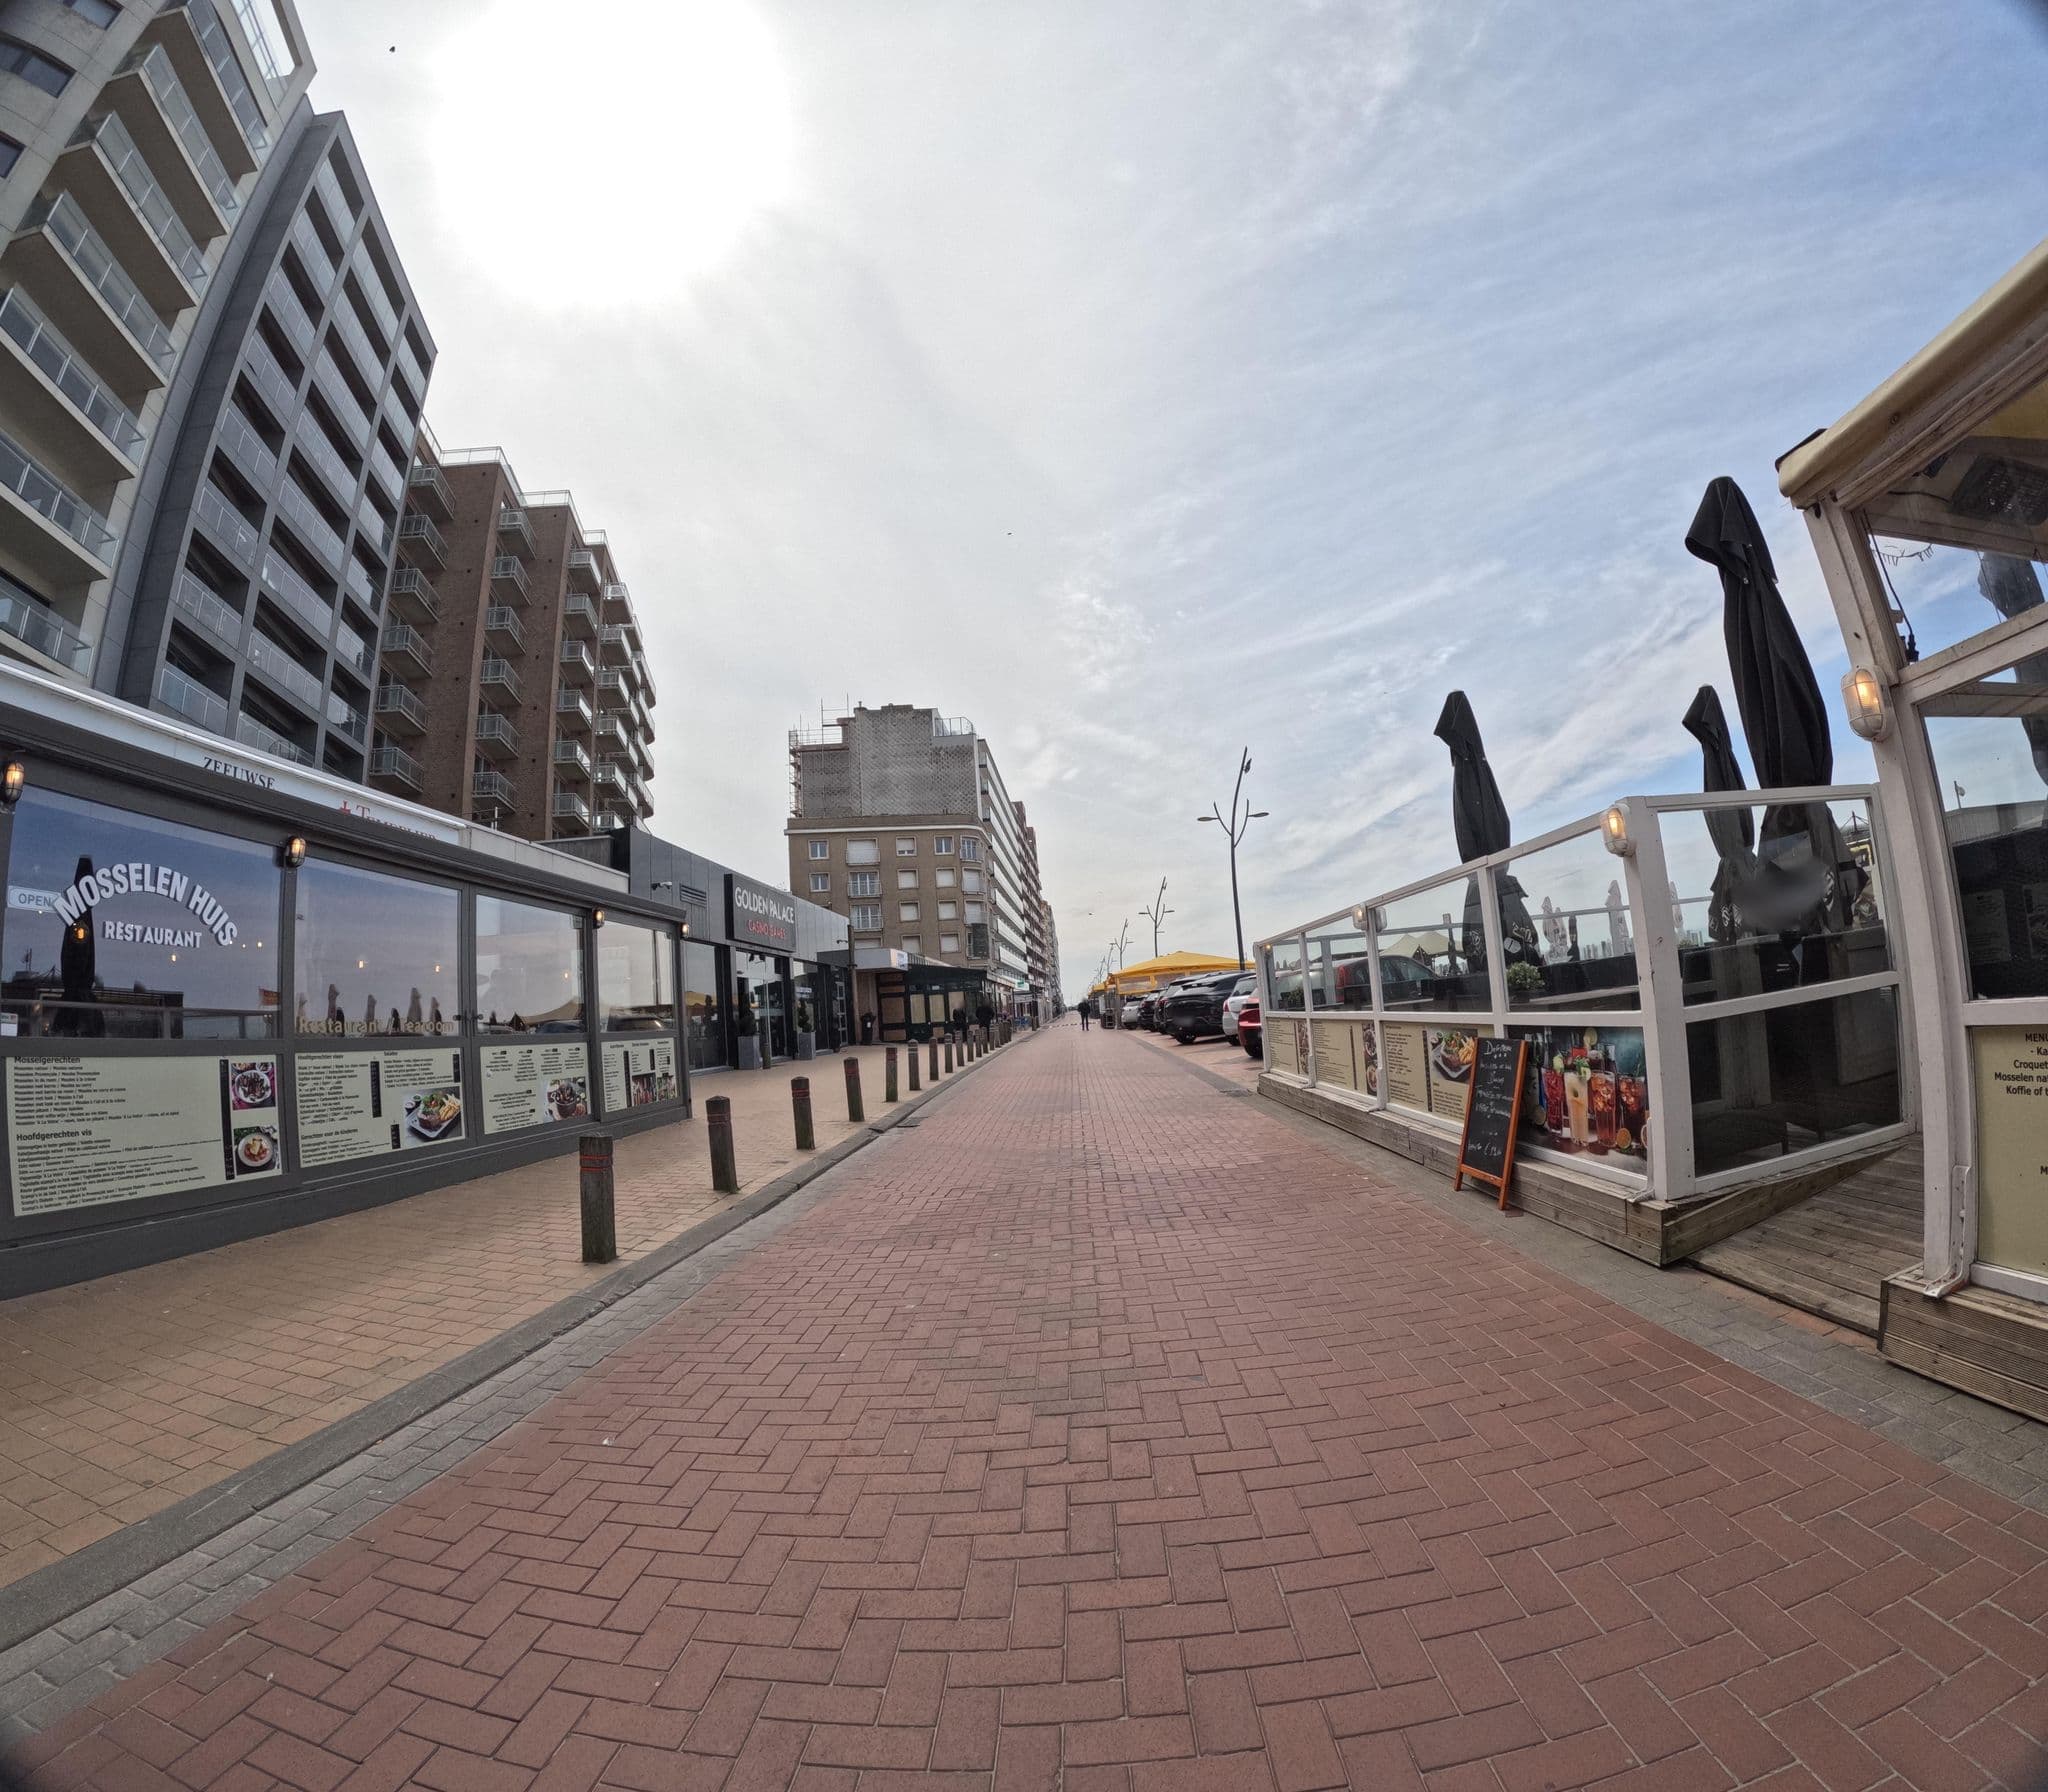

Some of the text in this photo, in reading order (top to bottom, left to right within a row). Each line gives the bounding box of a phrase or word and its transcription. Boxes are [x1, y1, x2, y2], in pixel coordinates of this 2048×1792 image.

[18, 893, 52, 906] OPEN
[53, 862, 238, 946] MOSSELEN HUIS
[735, 886, 795, 924] GOLDEN PALACE
[104, 920, 202, 948] RESTAURANT
[1994, 1072, 2034, 1082] Mosselen
[2006, 1085, 2031, 1096] Koffie
[2033, 1086, 2043, 1096] of
[16, 1128, 92, 1141] Hoofdgerechten vis
